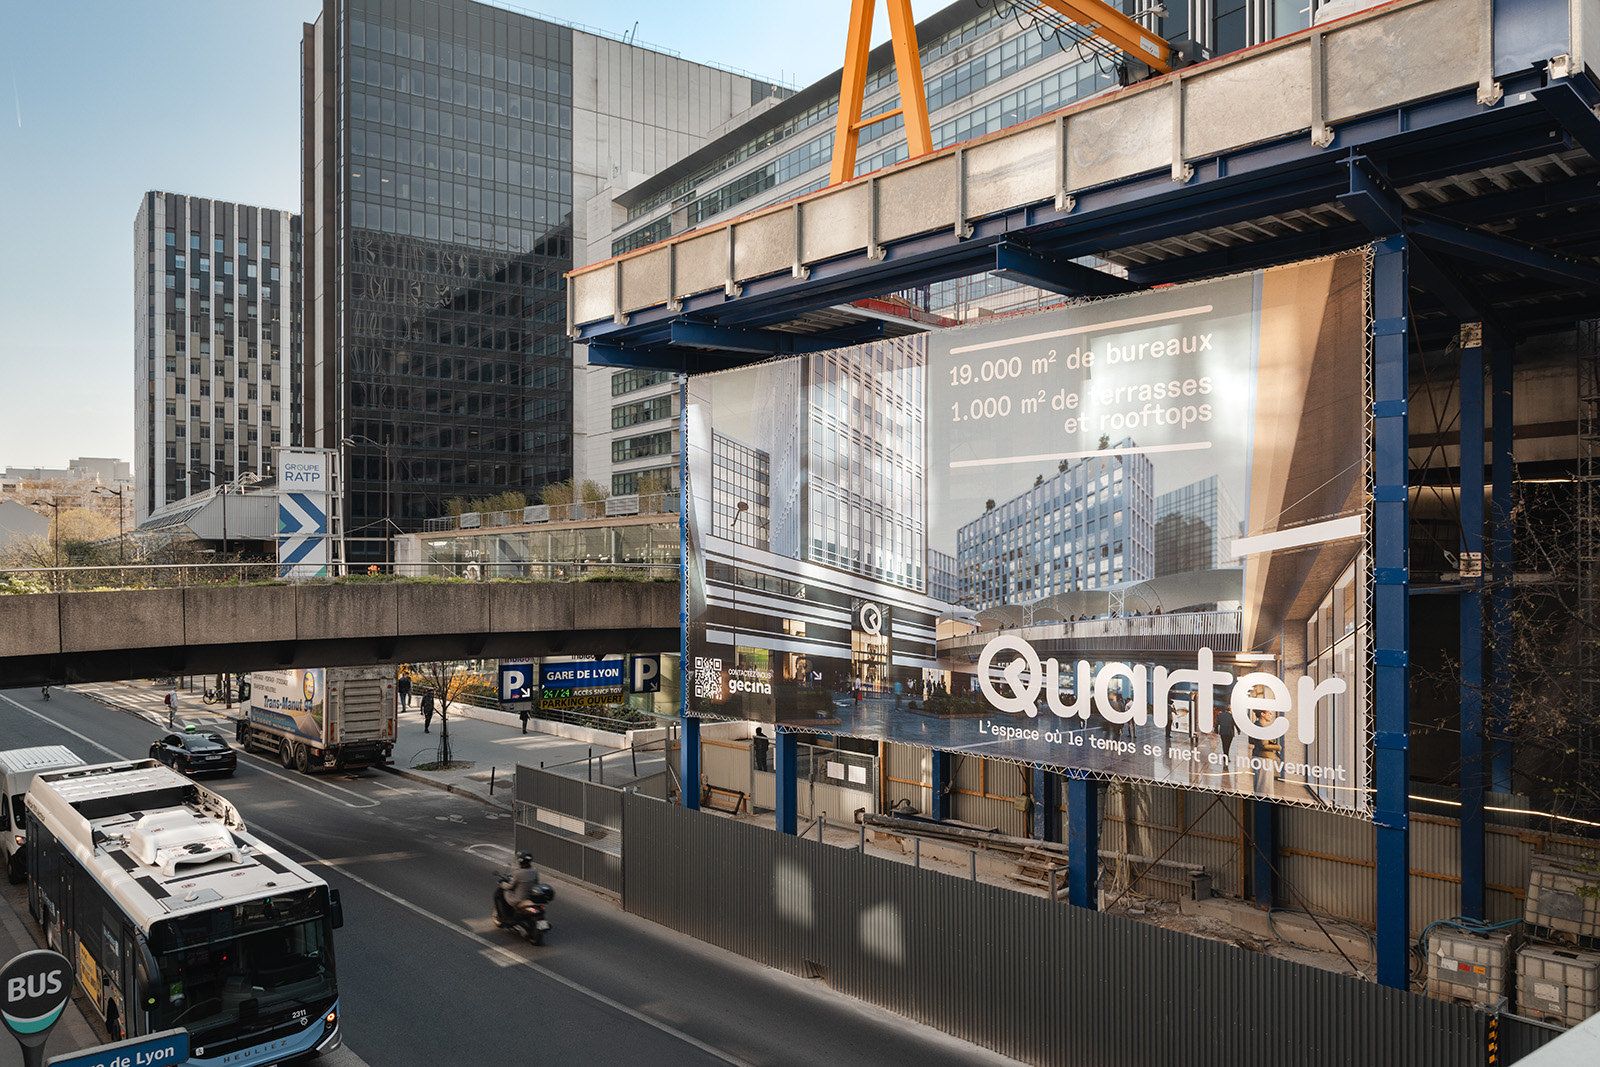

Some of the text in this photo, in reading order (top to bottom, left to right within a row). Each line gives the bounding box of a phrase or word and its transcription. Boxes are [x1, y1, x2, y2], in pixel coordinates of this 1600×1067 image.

[949, 356, 1022, 386] 19.000
[1066, 347, 1095, 370] de
[1106, 333, 1212, 365] bureaux
[951, 395, 1011, 422] 1.000
[1051, 388, 1079, 411] de
[1087, 376, 1213, 407] terrasses
[1064, 403, 1213, 434] et rooftops
[284, 463, 320, 472] GROUPE
[285, 471, 321, 482] RATP
[465, 549, 480, 558] RATP
[502, 670, 525, 700] P
[546, 668, 619, 681] GARE DE LYON
[634, 657, 659, 692] P
[728, 679, 772, 695] gecina
[977, 634, 1347, 745] Quarter
[264, 695, 303, 712] Trans-Manut
[542, 694, 624, 709] PARKING OUVERT
[1044, 729, 1062, 744] où
[1068, 731, 1084, 747] le
[1088, 733, 1137, 756] temps
[1143, 744, 1162, 757] se
[1169, 747, 1201, 763] met
[1208, 752, 1229, 766] en
[1236, 755, 1346, 782] mouvement
[8, 969, 62, 1003] BUS
[292, 1008, 307, 1019] 2311
[110, 1046, 175, 1067] de Lyon
[223, 1039, 288, 1064] HEULIEZ
